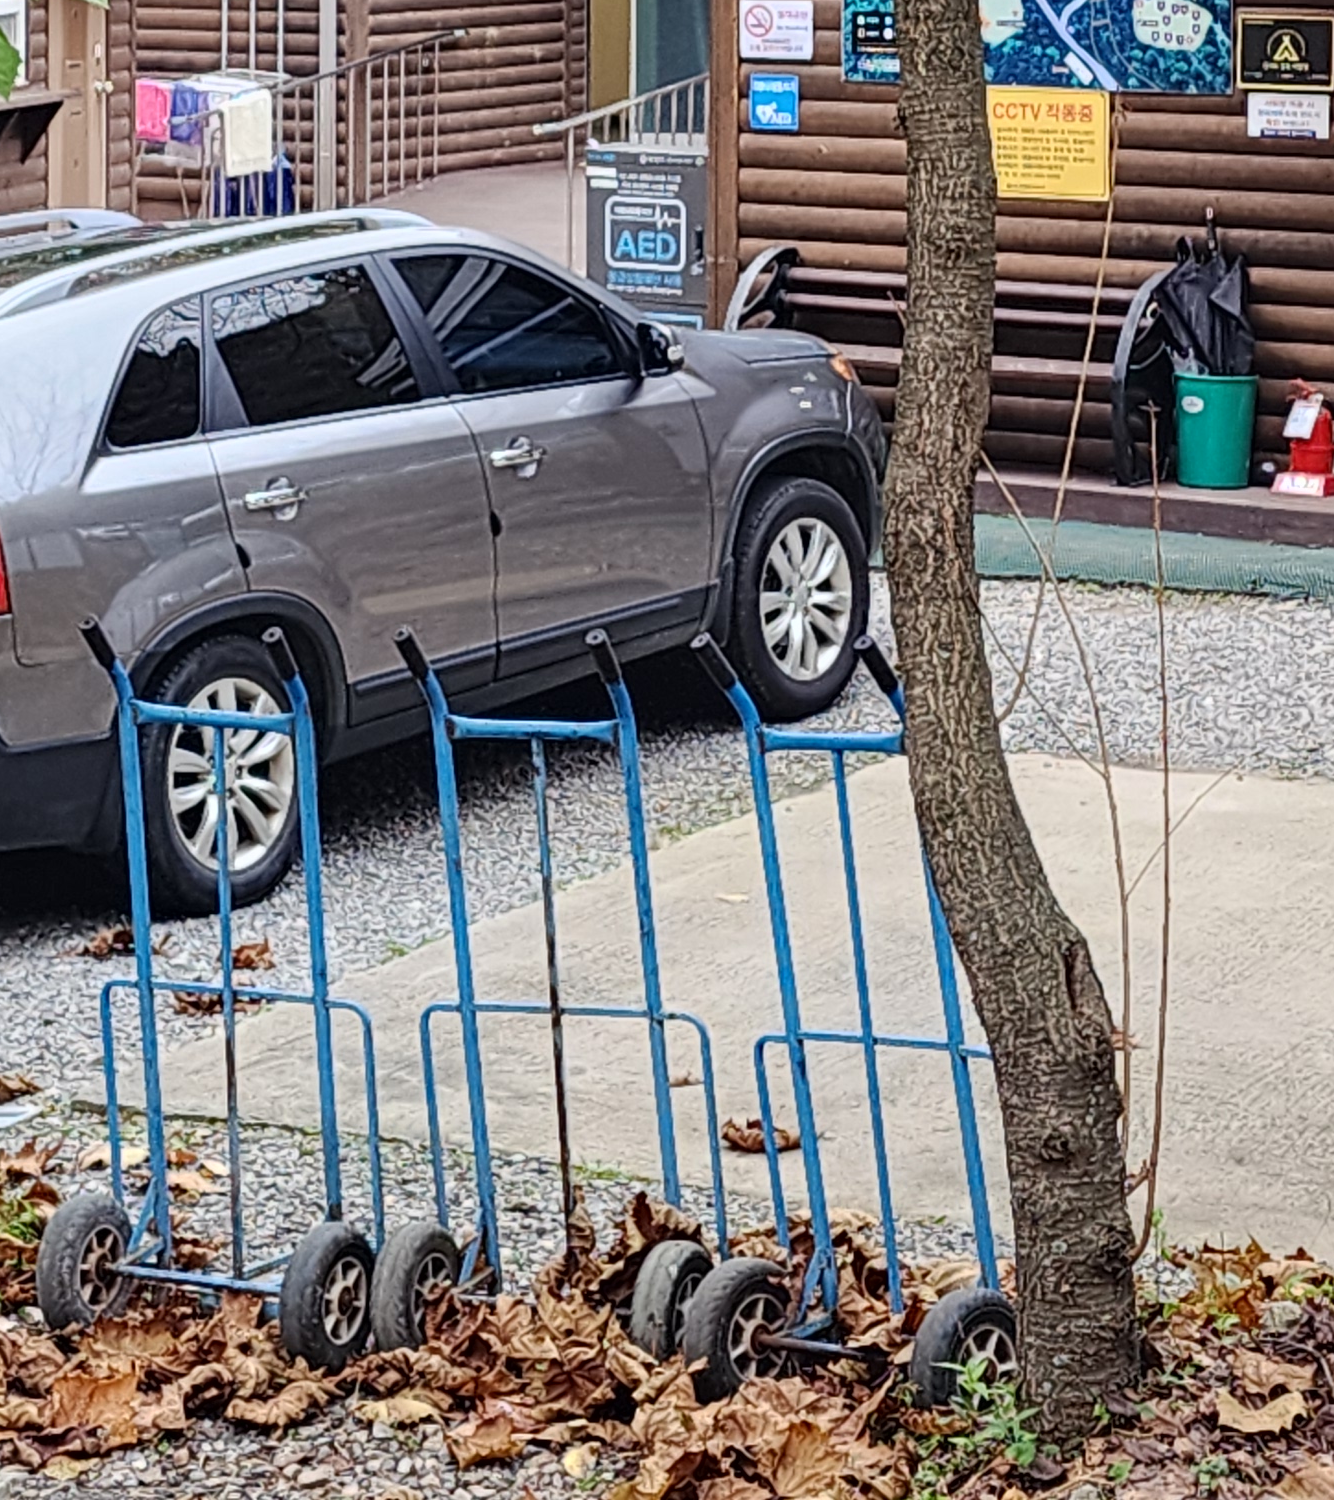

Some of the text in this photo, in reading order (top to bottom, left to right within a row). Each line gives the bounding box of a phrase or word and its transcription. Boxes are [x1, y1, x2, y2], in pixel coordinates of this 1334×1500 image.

[993, 102, 1093, 123] CCTV 작동중
[613, 229, 678, 261] AED
